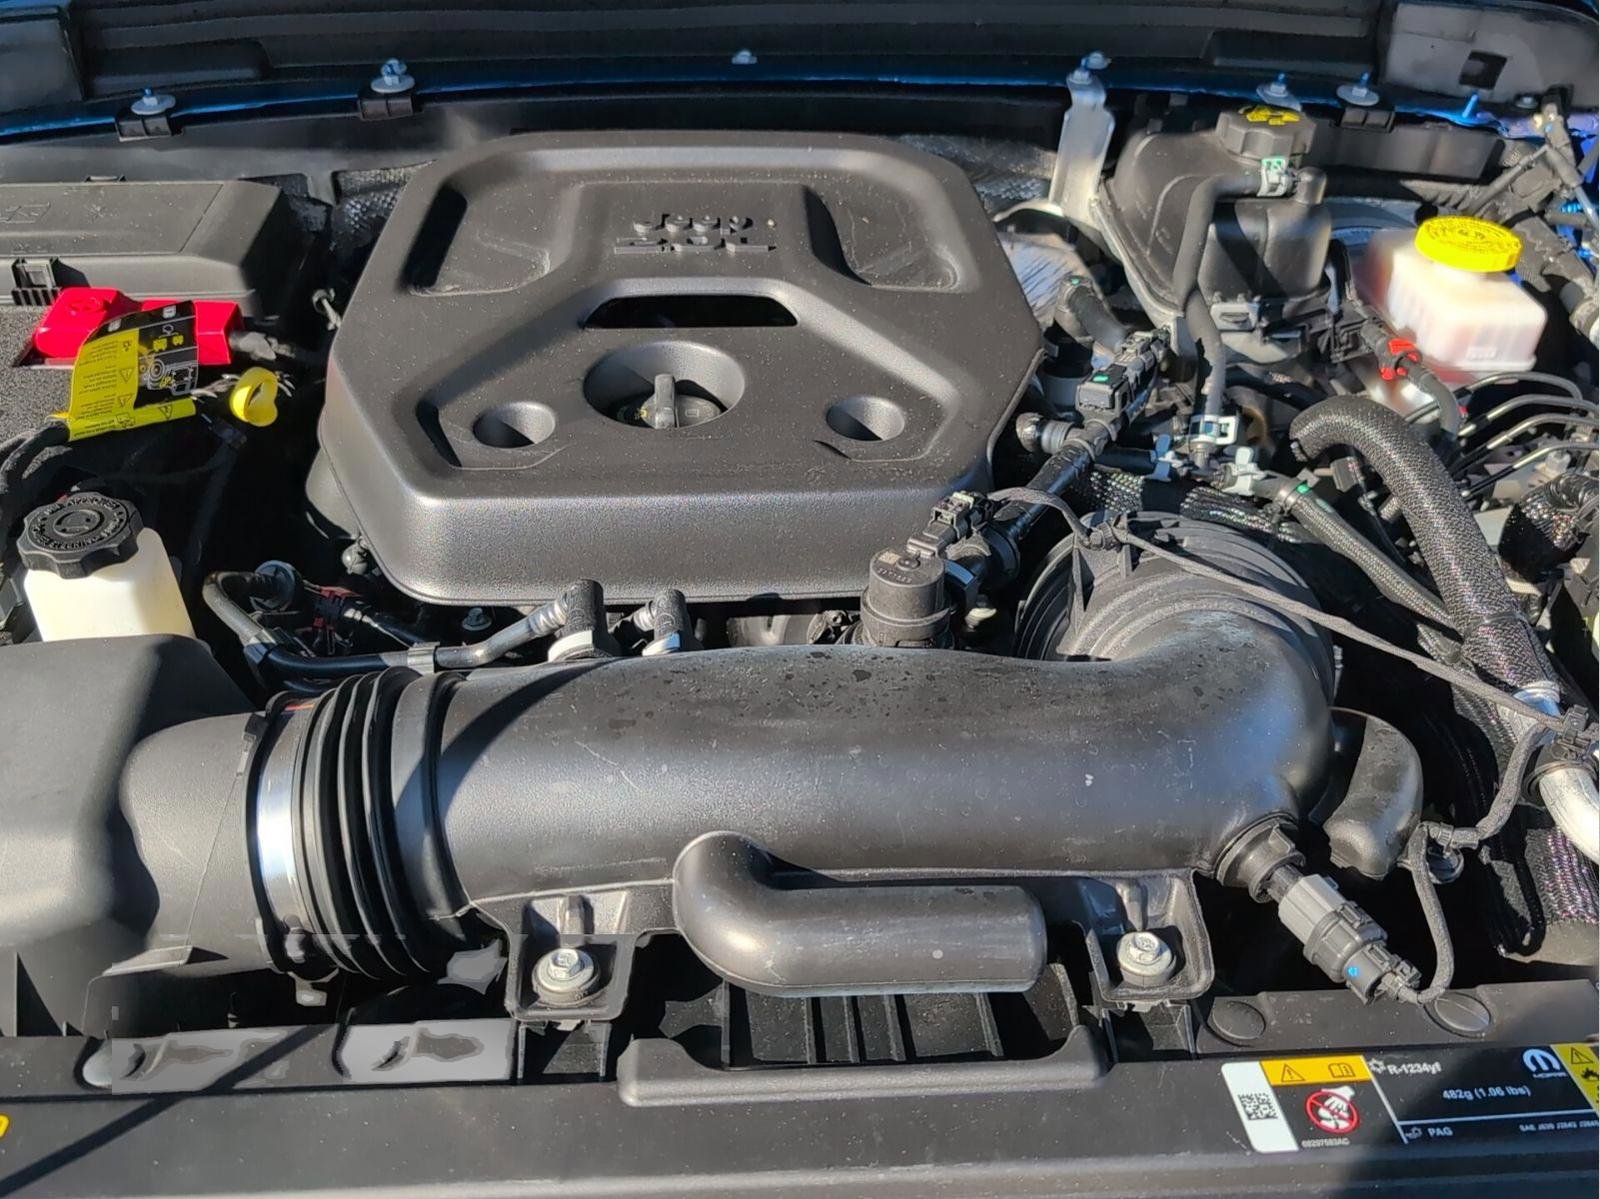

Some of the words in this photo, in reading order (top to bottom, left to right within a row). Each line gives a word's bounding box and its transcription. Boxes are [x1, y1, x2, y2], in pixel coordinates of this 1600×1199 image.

[1387, 1062, 1442, 1075] R-1234yf
[1442, 1089, 1473, 1101] 482g
[1474, 1086, 1504, 1099] (1.06
[1505, 1085, 1531, 1097] lbs)
[1427, 1127, 1453, 1137] PAG
